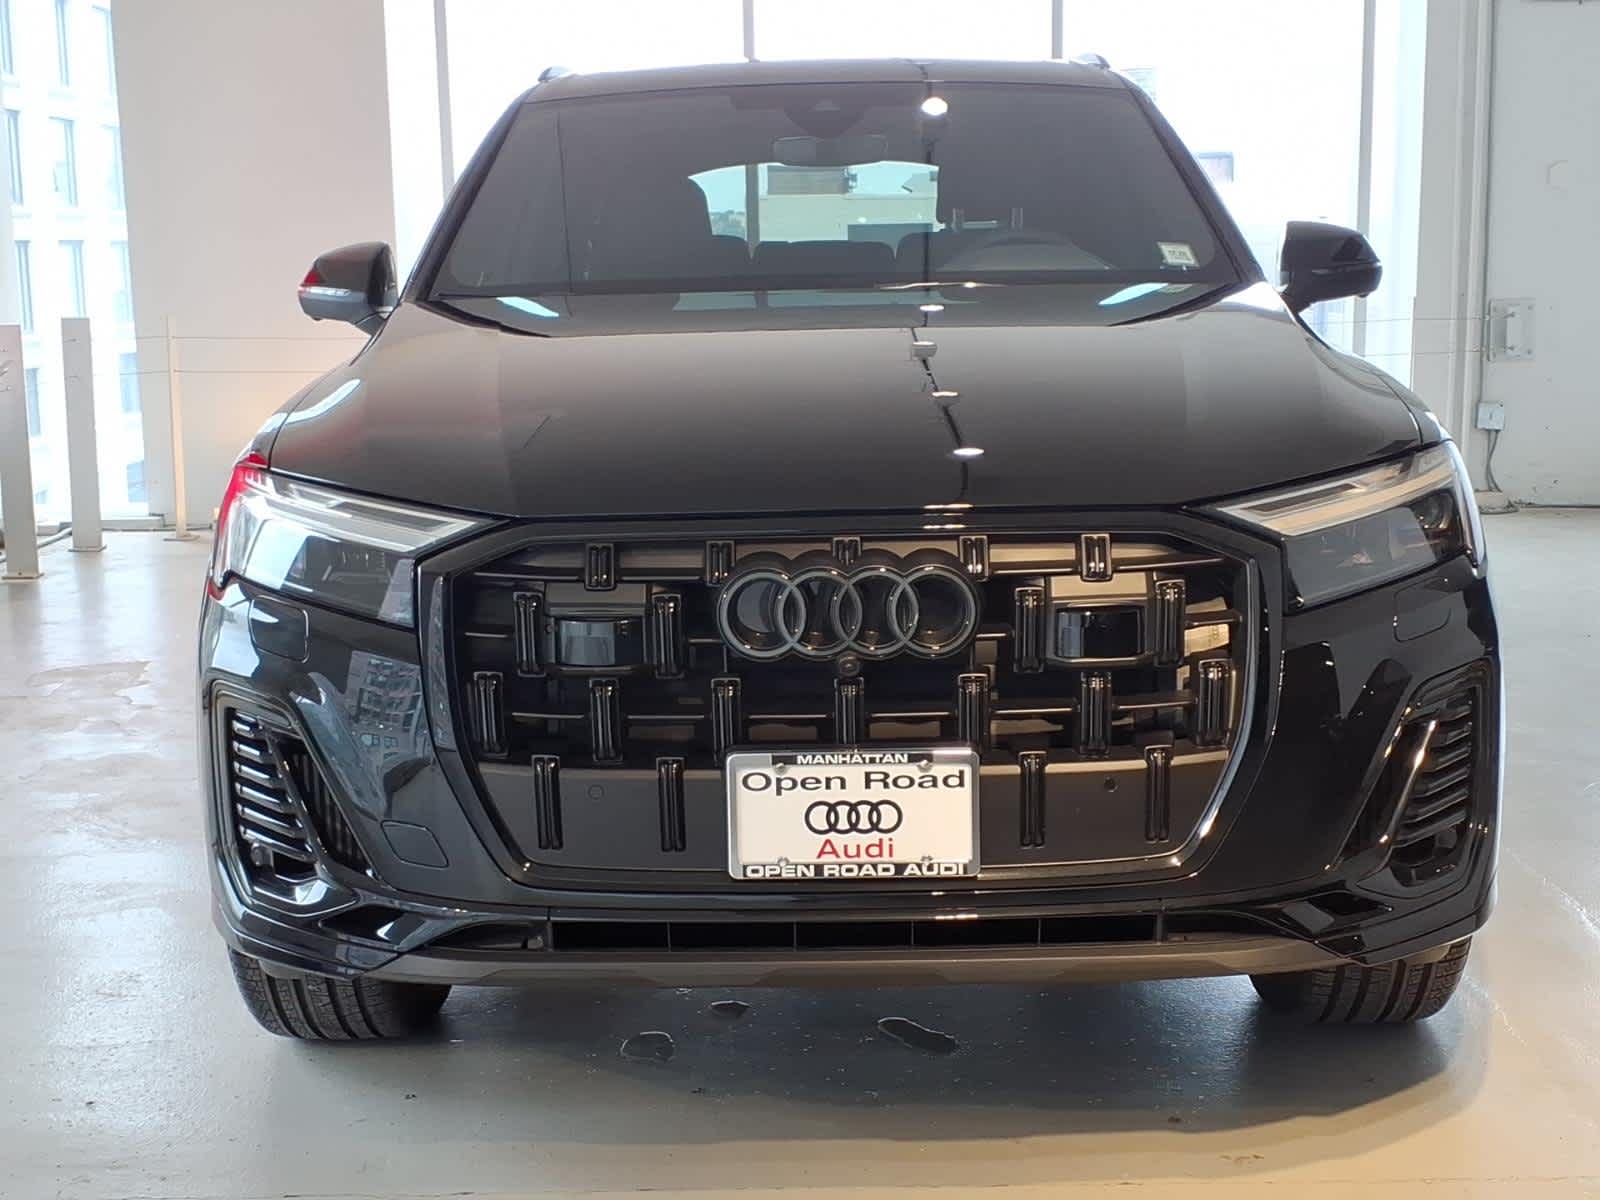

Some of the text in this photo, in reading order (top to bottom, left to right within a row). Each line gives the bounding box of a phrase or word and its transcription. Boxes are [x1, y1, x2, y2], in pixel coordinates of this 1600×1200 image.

[796, 753, 908, 765] MANHATTAN
[741, 769, 965, 796] Open Road
[816, 837, 894, 859] Audi
[745, 863, 965, 877] OPEN ROAD AUDI
